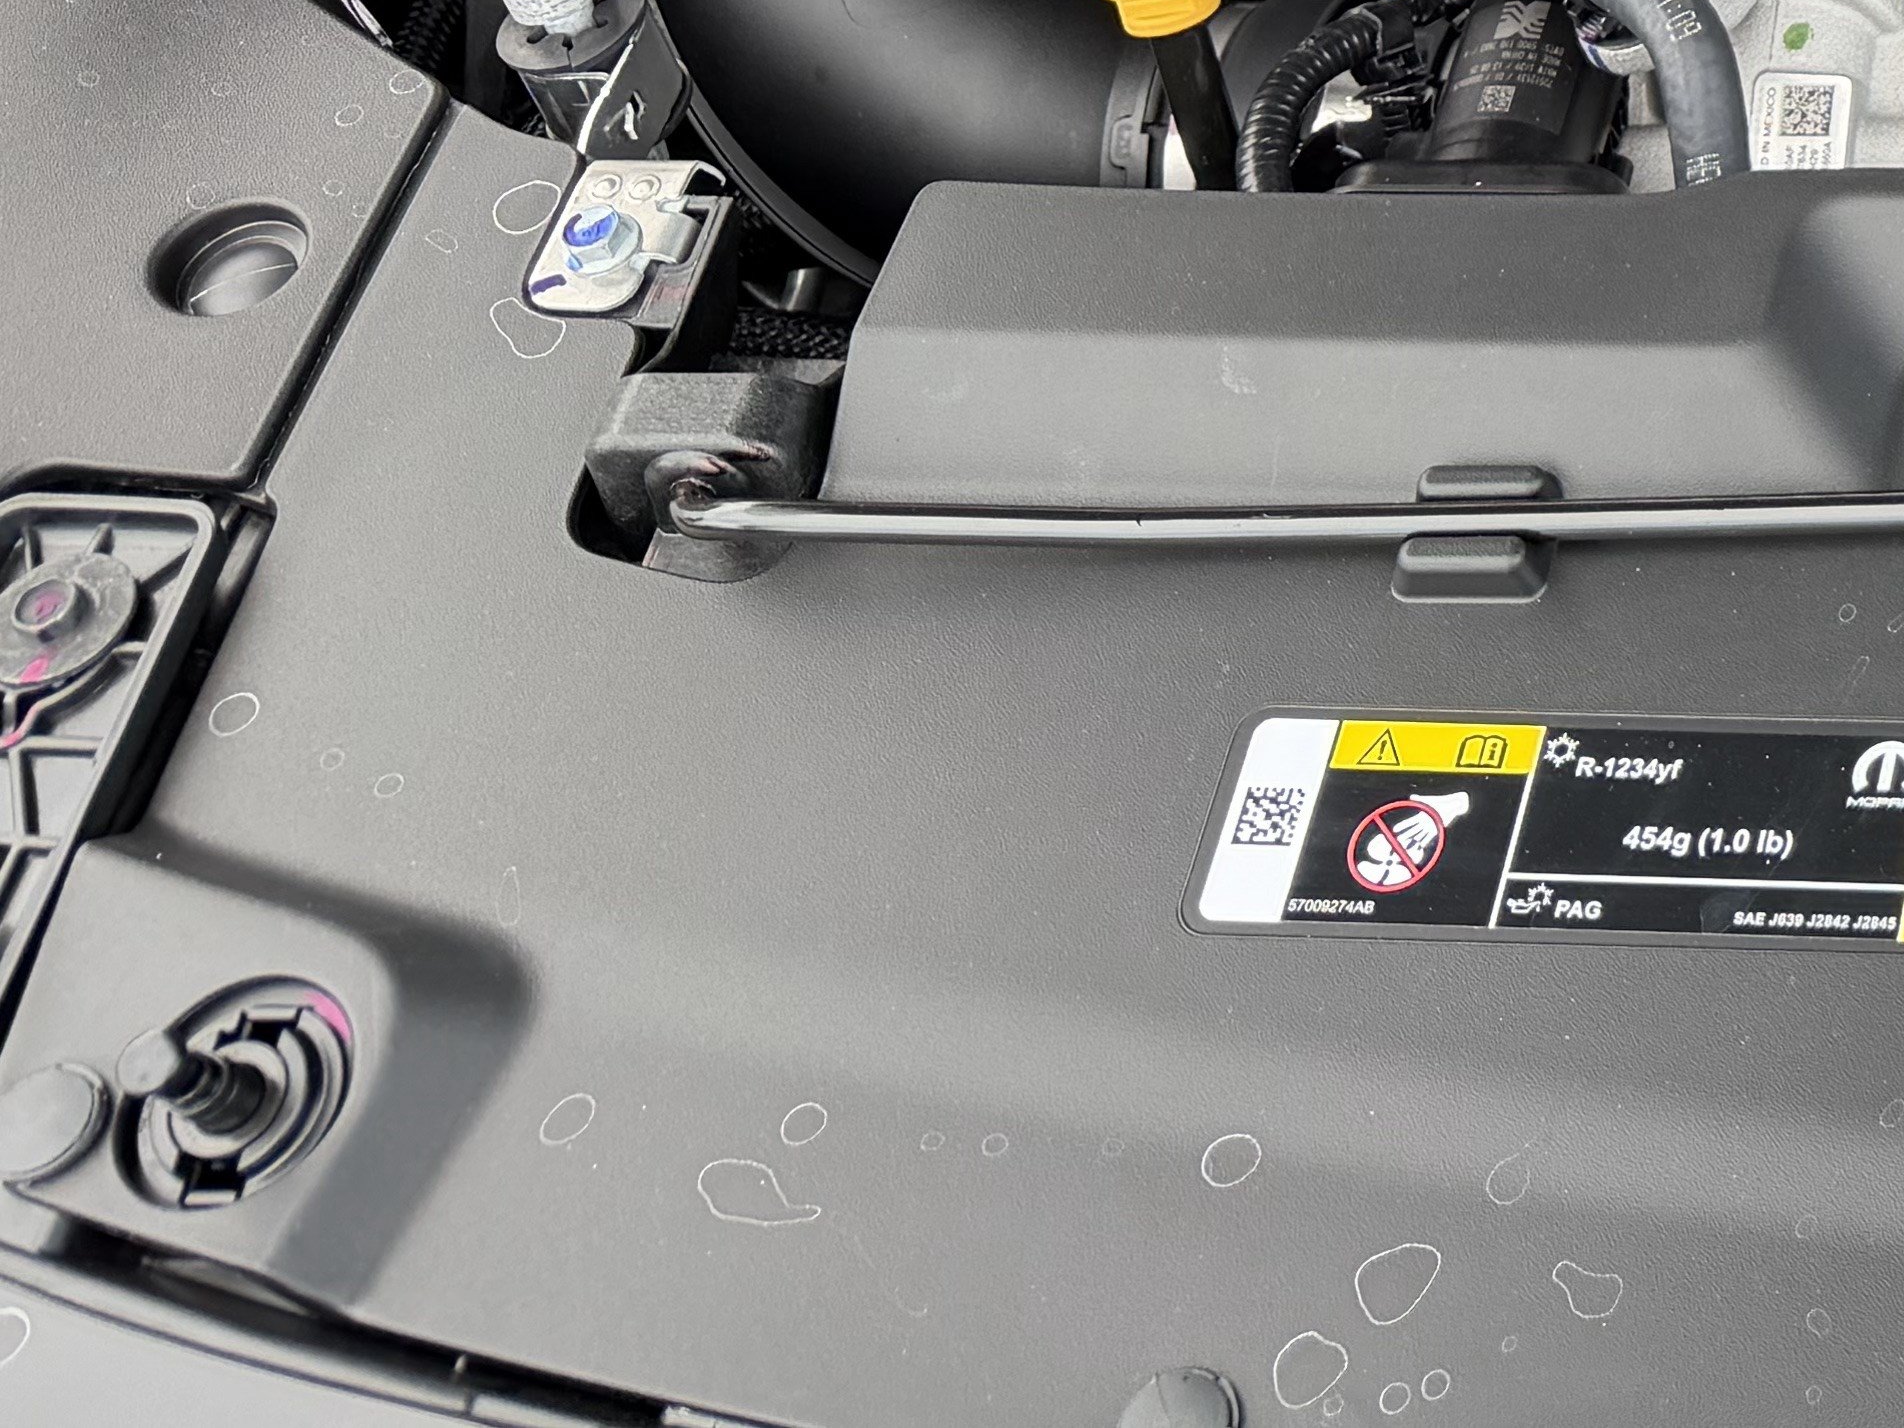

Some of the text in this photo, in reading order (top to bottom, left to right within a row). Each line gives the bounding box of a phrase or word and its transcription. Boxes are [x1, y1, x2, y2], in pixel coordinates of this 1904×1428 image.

[1763, 87, 1777, 137] MEXICO
[1762, 141, 1770, 150] IN
[1575, 756, 1684, 784] R-1234yf
[1622, 825, 1794, 860] 454g (1.0 lb)
[1554, 899, 1603, 921] PAG
[1733, 910, 1766, 926] SAE
[1806, 913, 1851, 930] J2842
[1853, 915, 1898, 931] J2845
